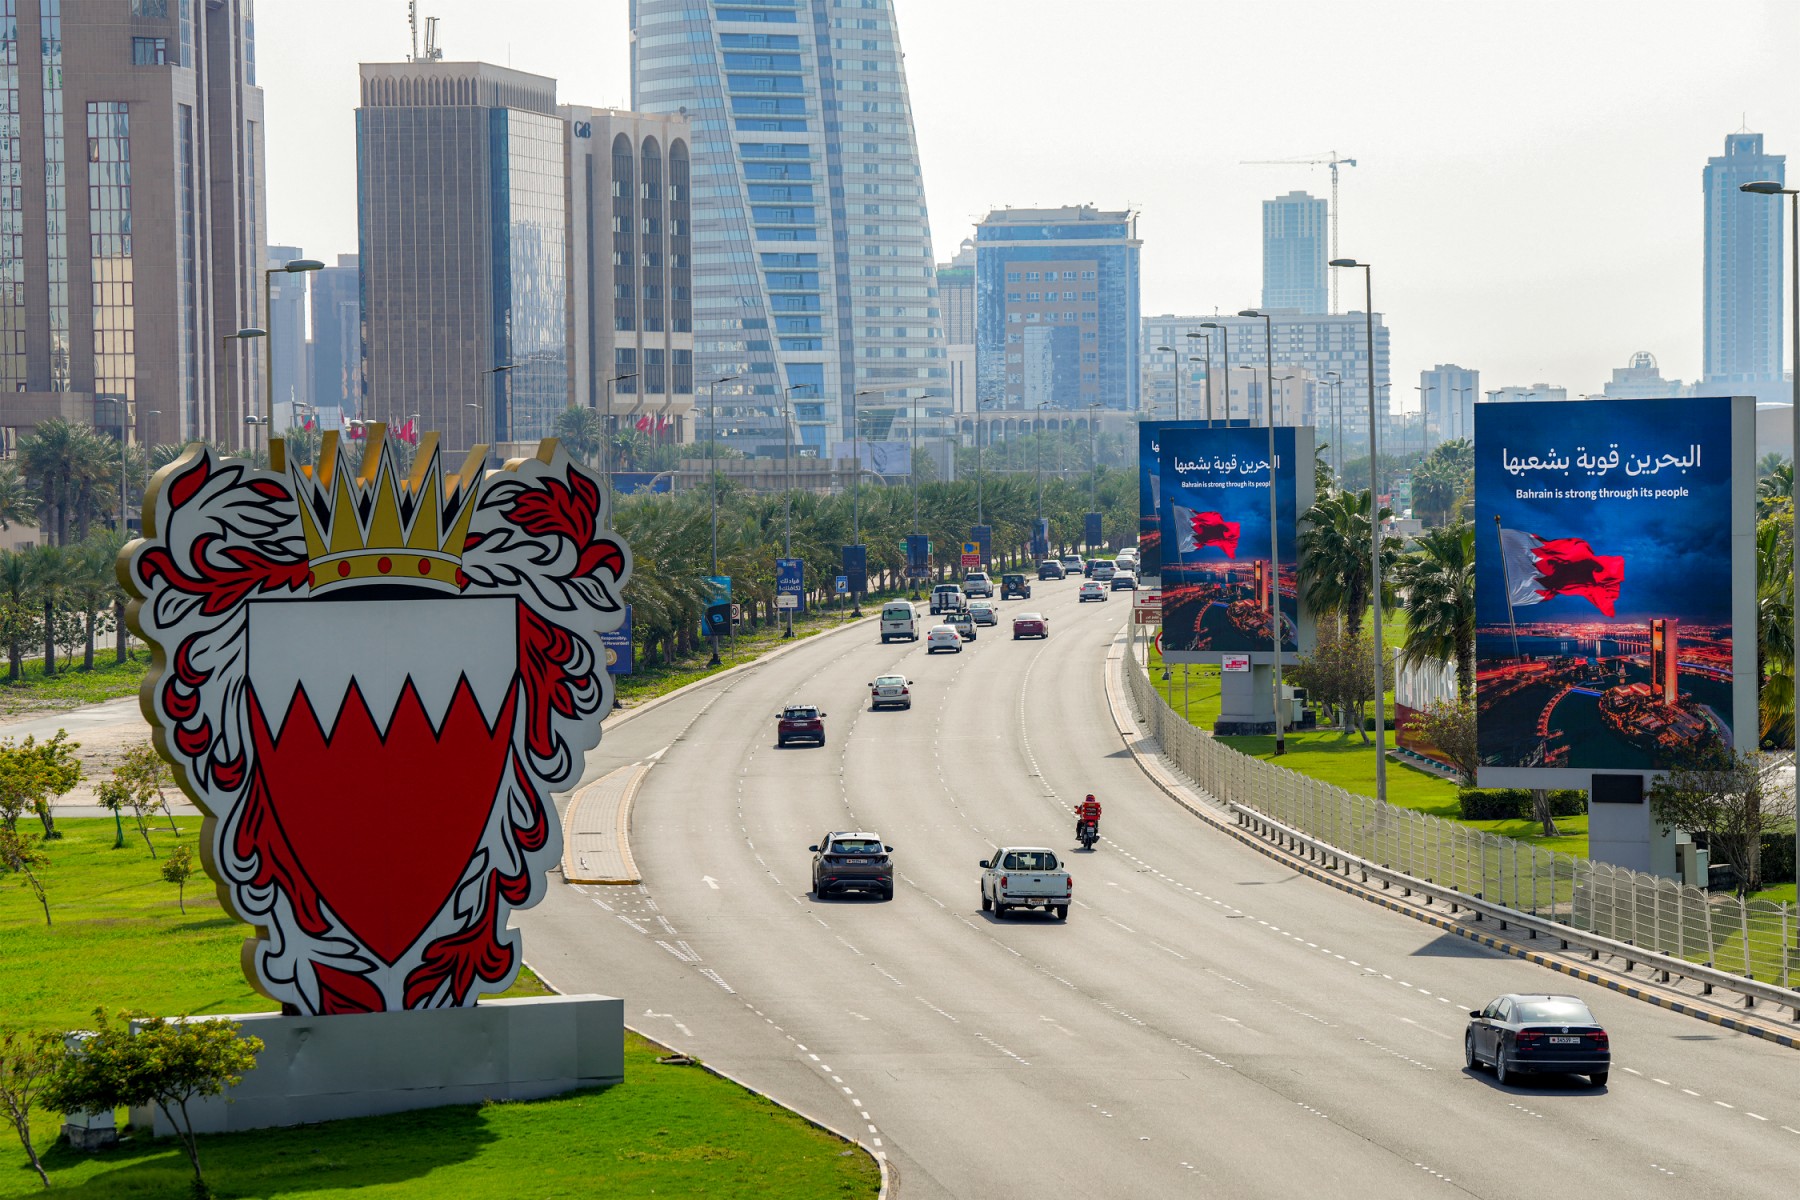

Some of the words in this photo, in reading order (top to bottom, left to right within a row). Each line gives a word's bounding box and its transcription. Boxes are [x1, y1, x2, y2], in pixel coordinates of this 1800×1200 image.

[1174, 456, 1211, 474] بشعبها
[1213, 454, 1237, 474] قوية
[1239, 454, 1280, 474] الحرين
[1503, 447, 1570, 477] بشعبها
[1576, 443, 1619, 477] قوية
[1625, 444, 1701, 477] البحرين
[1207, 481, 1226, 489] strong
[1225, 480, 1247, 489] through
[1255, 480, 1270, 489] peopl
[1516, 488, 1553, 499] Bahrain
[1555, 488, 1563, 499] is
[1564, 488, 1597, 501] strong
[1599, 487, 1639, 500] through
[1640, 486, 1653, 498] its
[1654, 486, 1689, 500] people
